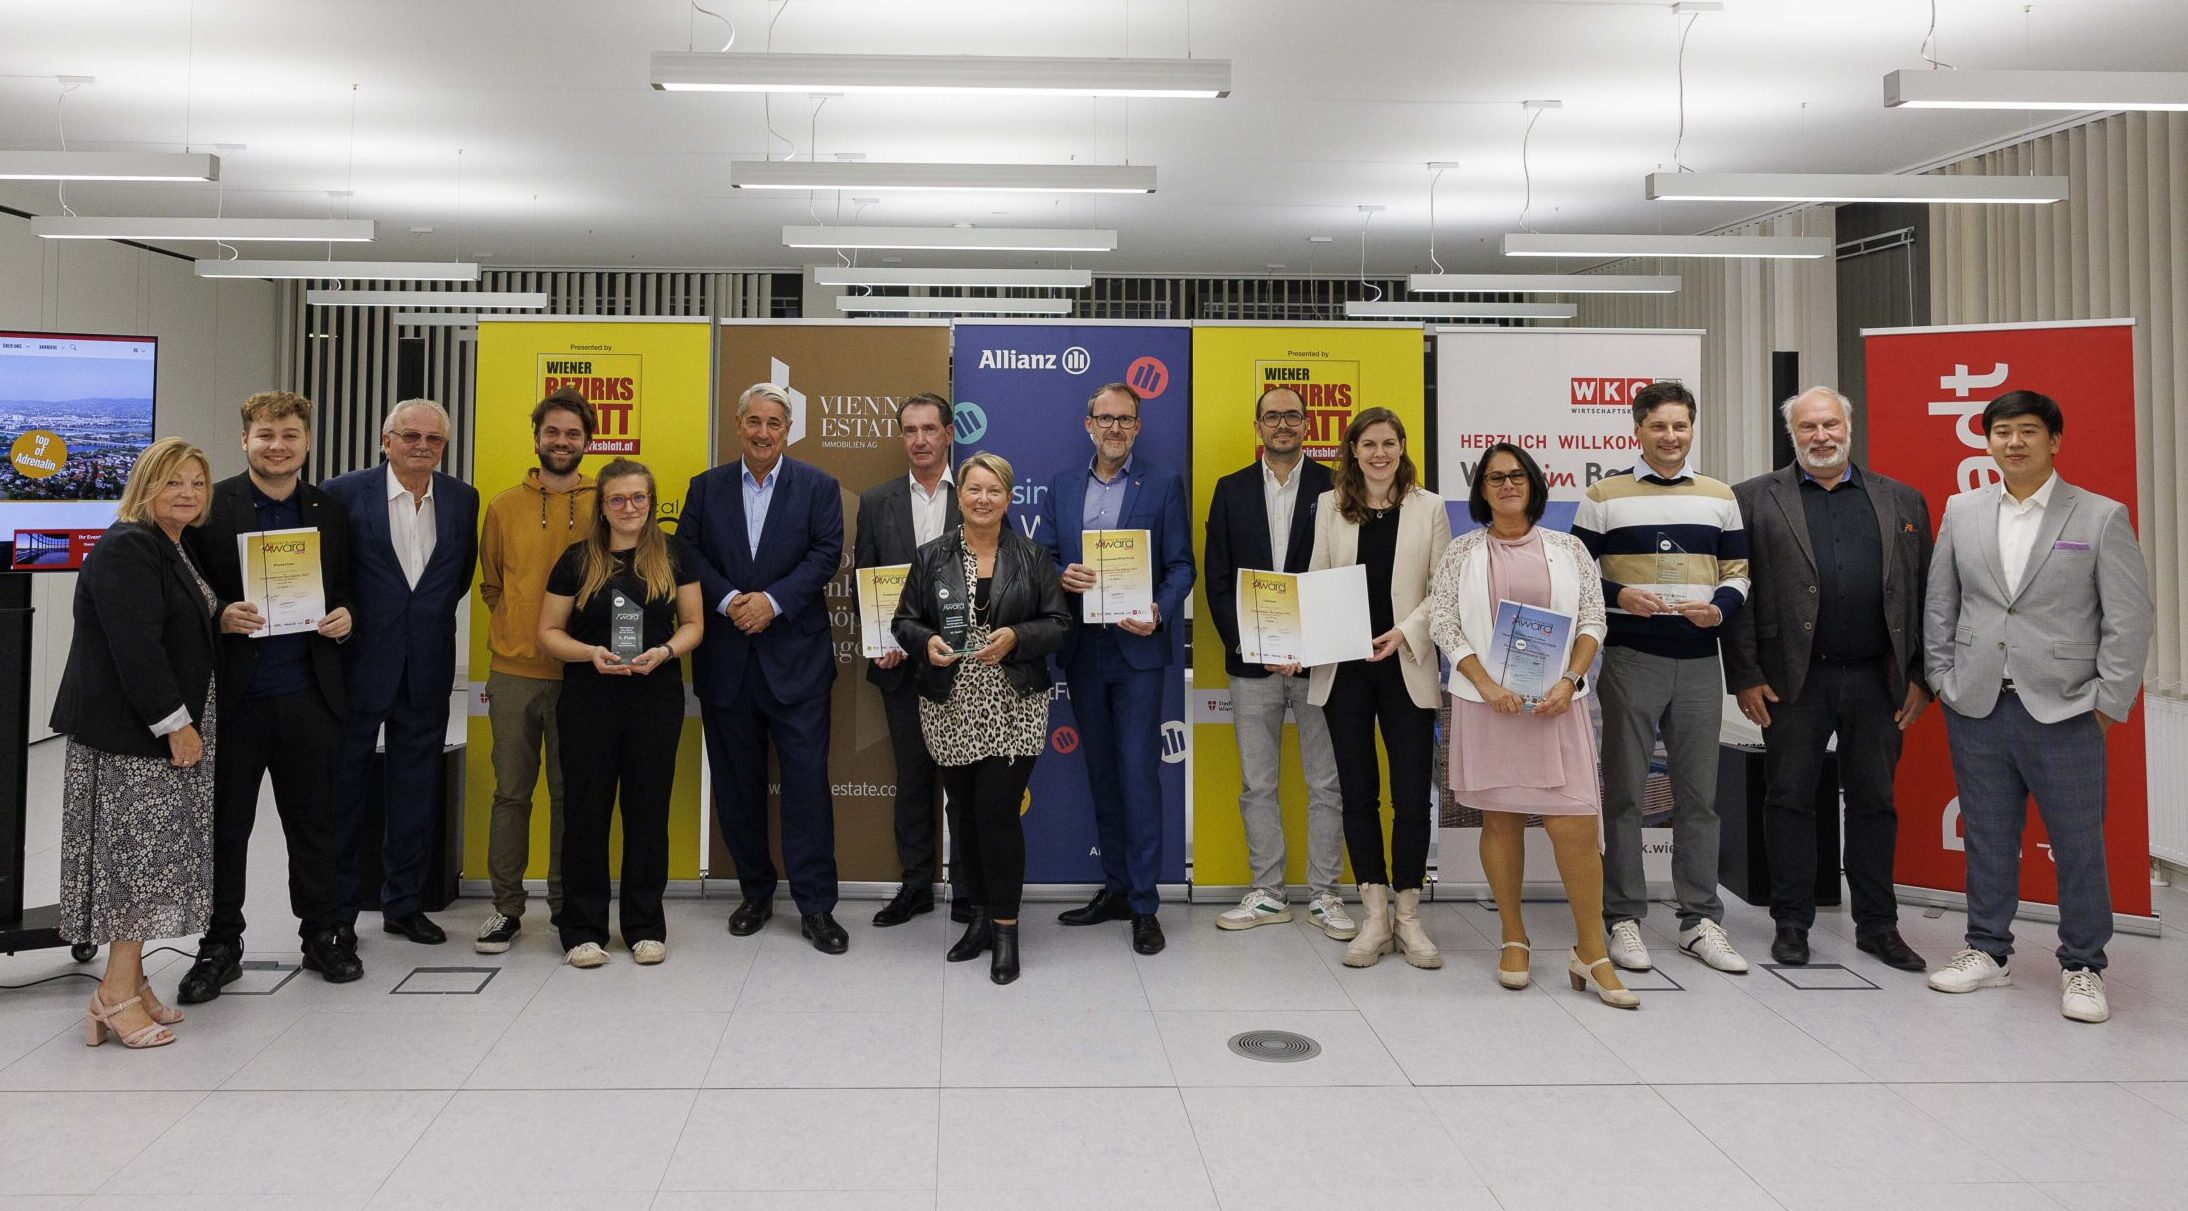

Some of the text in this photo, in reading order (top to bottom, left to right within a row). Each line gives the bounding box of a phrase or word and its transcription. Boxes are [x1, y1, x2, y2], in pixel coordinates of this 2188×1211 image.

[604, 344, 612, 352] by
[1322, 350, 1329, 358] by
[979, 349, 1057, 369] Allianz
[547, 361, 592, 374] WIENER
[1265, 368, 1310, 380] WIENER
[818, 395, 902, 415] VIENN
[591, 403, 634, 435] ATT
[1303, 409, 1352, 441] ATT
[820, 418, 903, 438] ESTAT
[1928, 363, 2009, 493] adt
[35, 434, 50, 446] top
[1558, 435, 1642, 450] WILLKOM
[34, 446, 46, 456] of
[15, 453, 56, 471] Adrenalin
[263, 541, 306, 554] Award
[1096, 538, 1134, 549] Award
[1253, 579, 1287, 593] Award
[1512, 616, 1554, 635] Award
